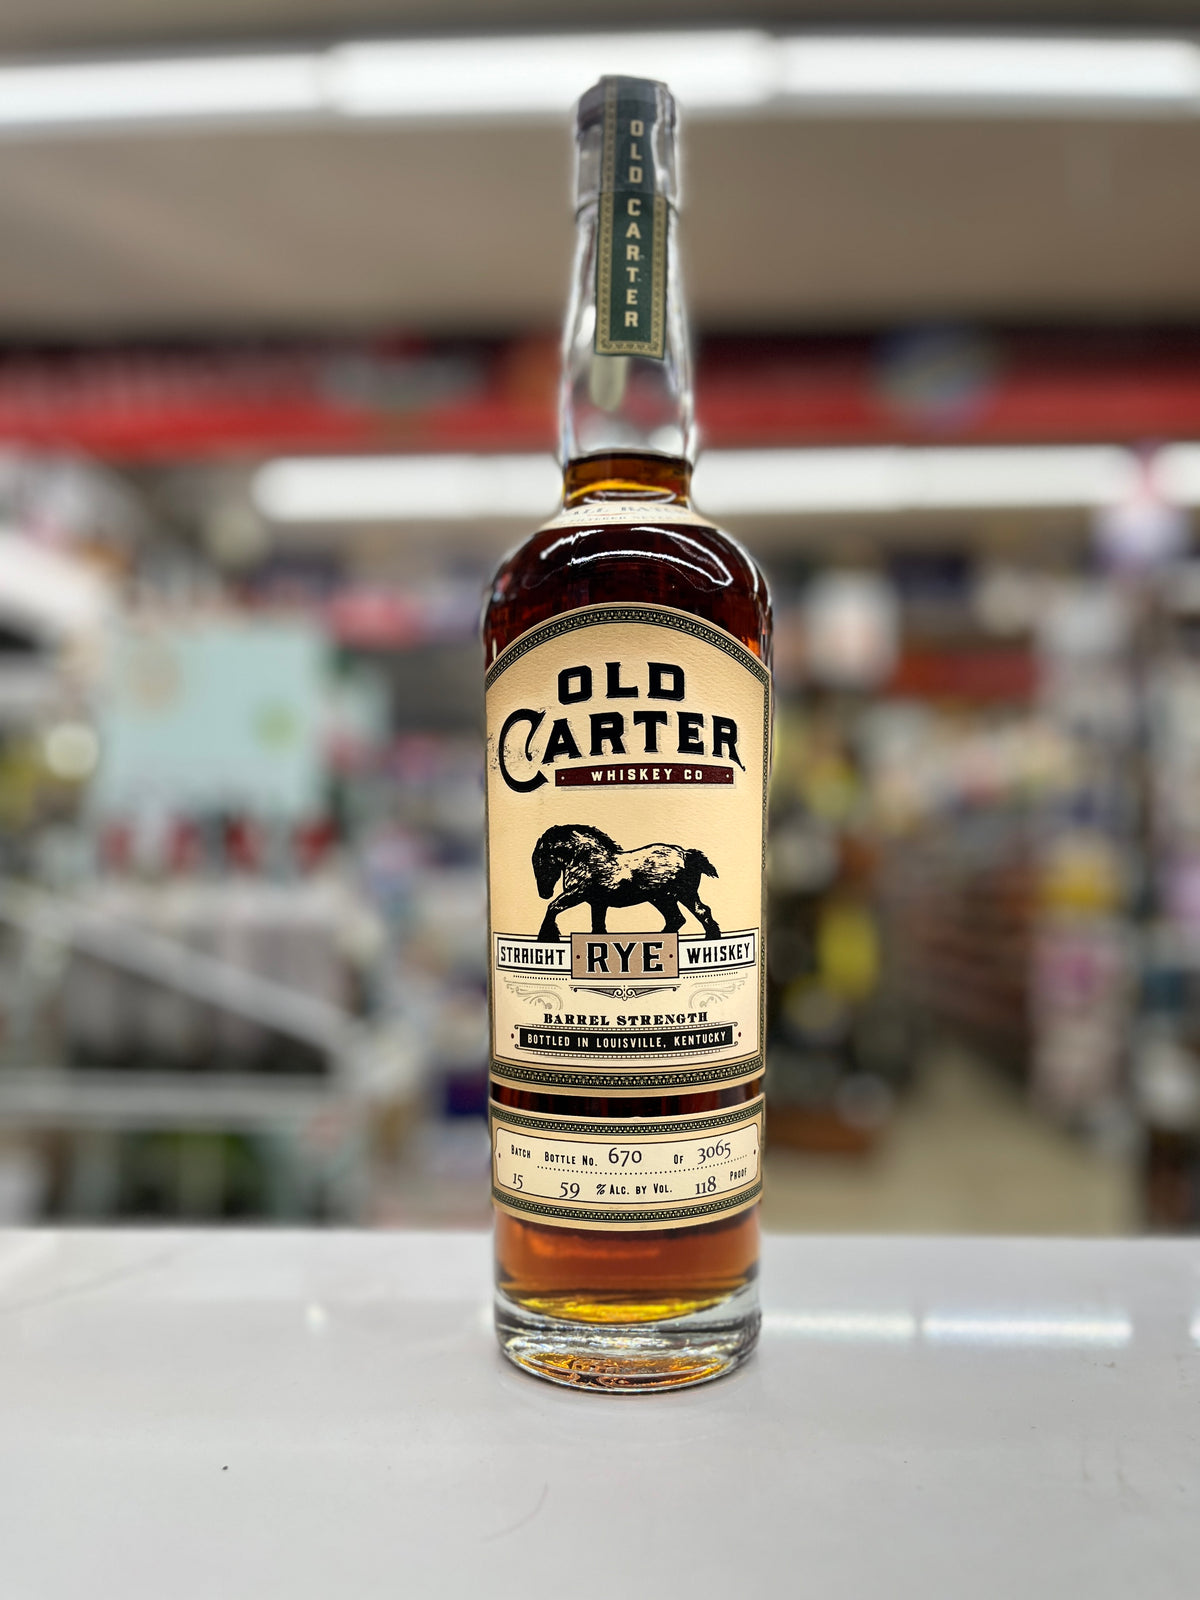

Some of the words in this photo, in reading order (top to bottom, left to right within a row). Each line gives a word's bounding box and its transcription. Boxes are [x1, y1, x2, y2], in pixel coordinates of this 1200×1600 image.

[629, 119, 645, 184] OLD
[625, 198, 641, 328] CARTER
[558, 661, 685, 705] OLD
[499, 708, 746, 793] CARTER
[591, 768, 673, 782] WHISKEY
[684, 769, 704, 781] CO
[500, 946, 566, 966] STRAIGHT
[586, 941, 664, 973] RYE
[686, 942, 751, 964] WHISKEY
[543, 1013, 610, 1026] BARREL
[617, 1011, 708, 1026] STRENGTH
[527, 1033, 571, 1047] BOTTLED
[577, 1037, 589, 1048] IN
[596, 1038, 667, 1049] LOUISVILLE,
[674, 1031, 727, 1047] KENTUCKY
[608, 1147, 643, 1168] 670
[697, 1139, 732, 1165] 3065
[512, 1172, 524, 1190] 15
[559, 1182, 581, 1199] 59
[695, 1175, 717, 1195] 118
